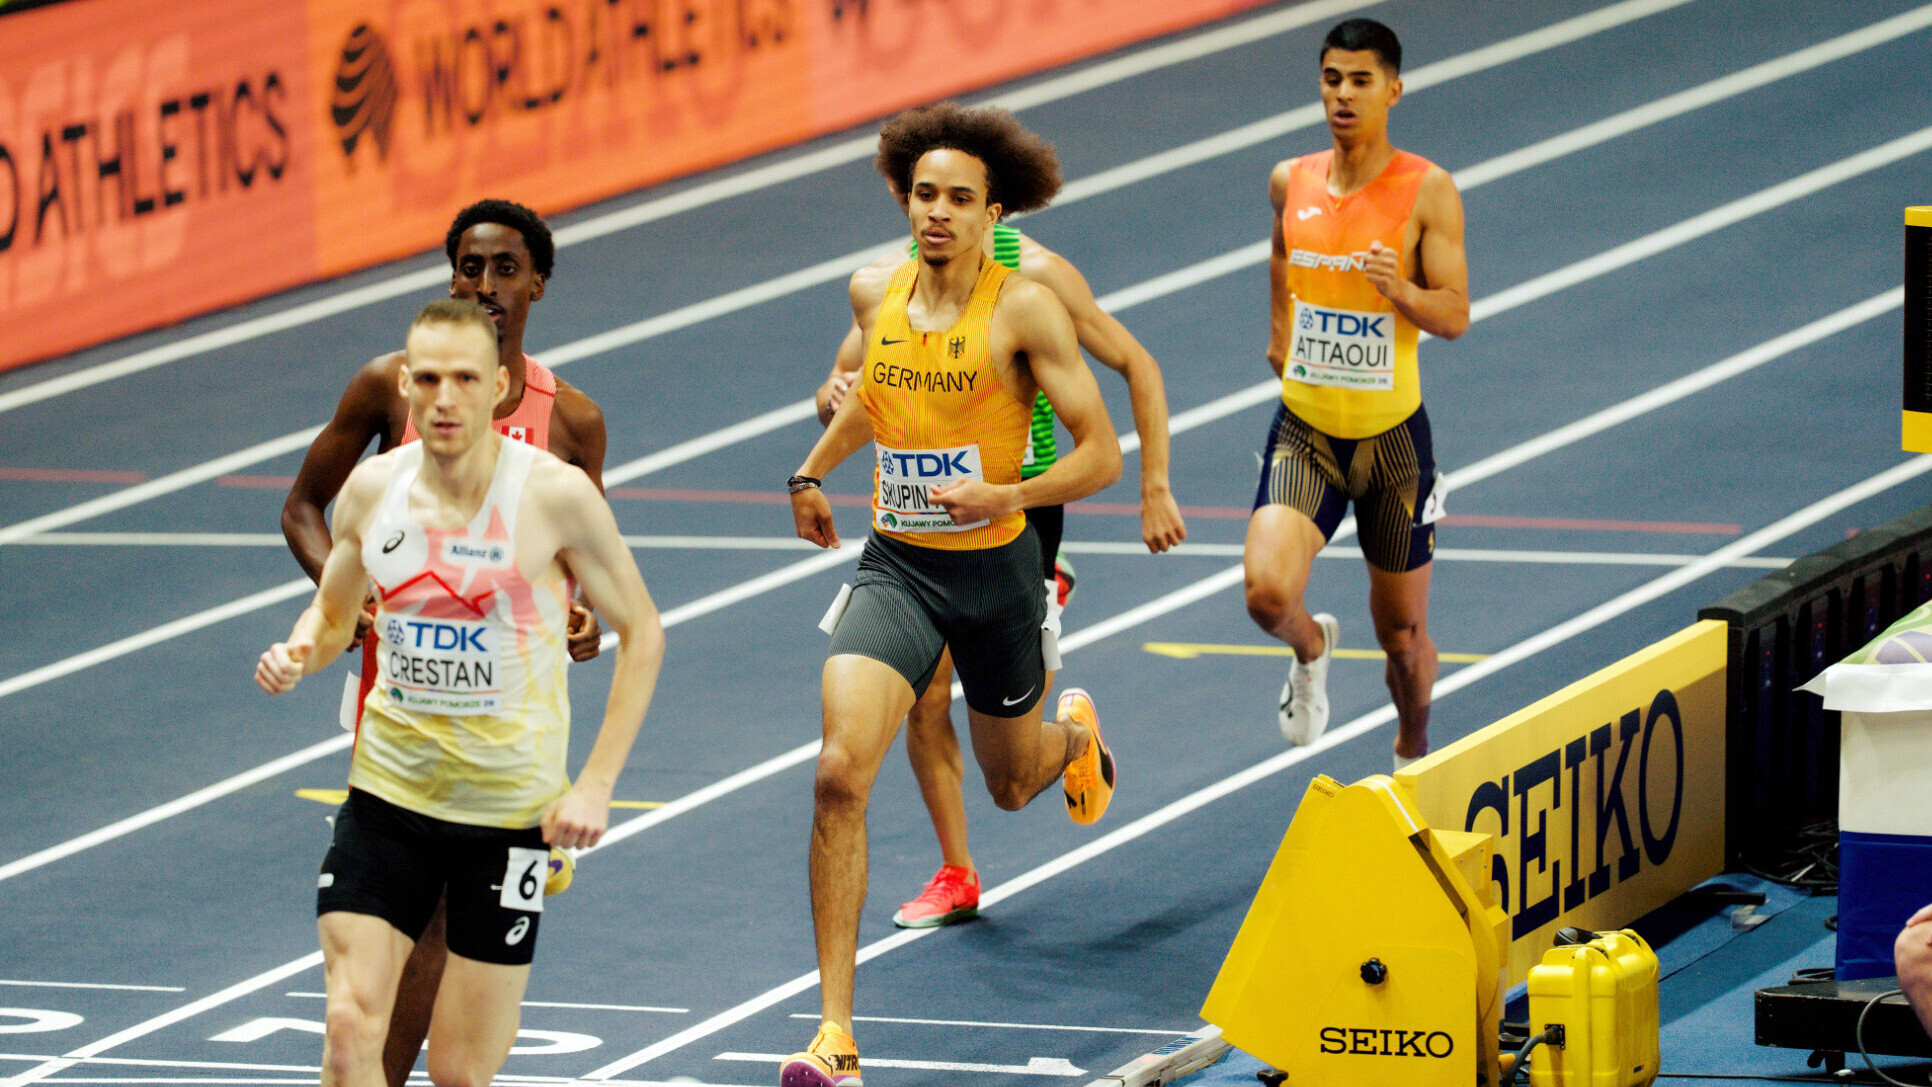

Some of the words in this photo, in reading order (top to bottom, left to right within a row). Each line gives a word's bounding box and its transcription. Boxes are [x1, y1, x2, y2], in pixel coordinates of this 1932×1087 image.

[413, 4, 573, 142] WORLD
[33, 67, 289, 247] ATHLETICS
[1315, 310, 1386, 338] TDK
[1295, 335, 1388, 367] ATTAOUI
[873, 361, 978, 393] GERMANY
[892, 450, 973, 478] TDK
[900, 519, 931, 528] KUJAWY
[451, 544, 487, 558] Allianz
[406, 621, 488, 653] TDK
[388, 650, 493, 688] CRESTAN
[1464, 689, 1685, 943] SEIKO
[518, 859, 538, 901] 6
[1319, 1026, 1454, 1059] SEIKO
